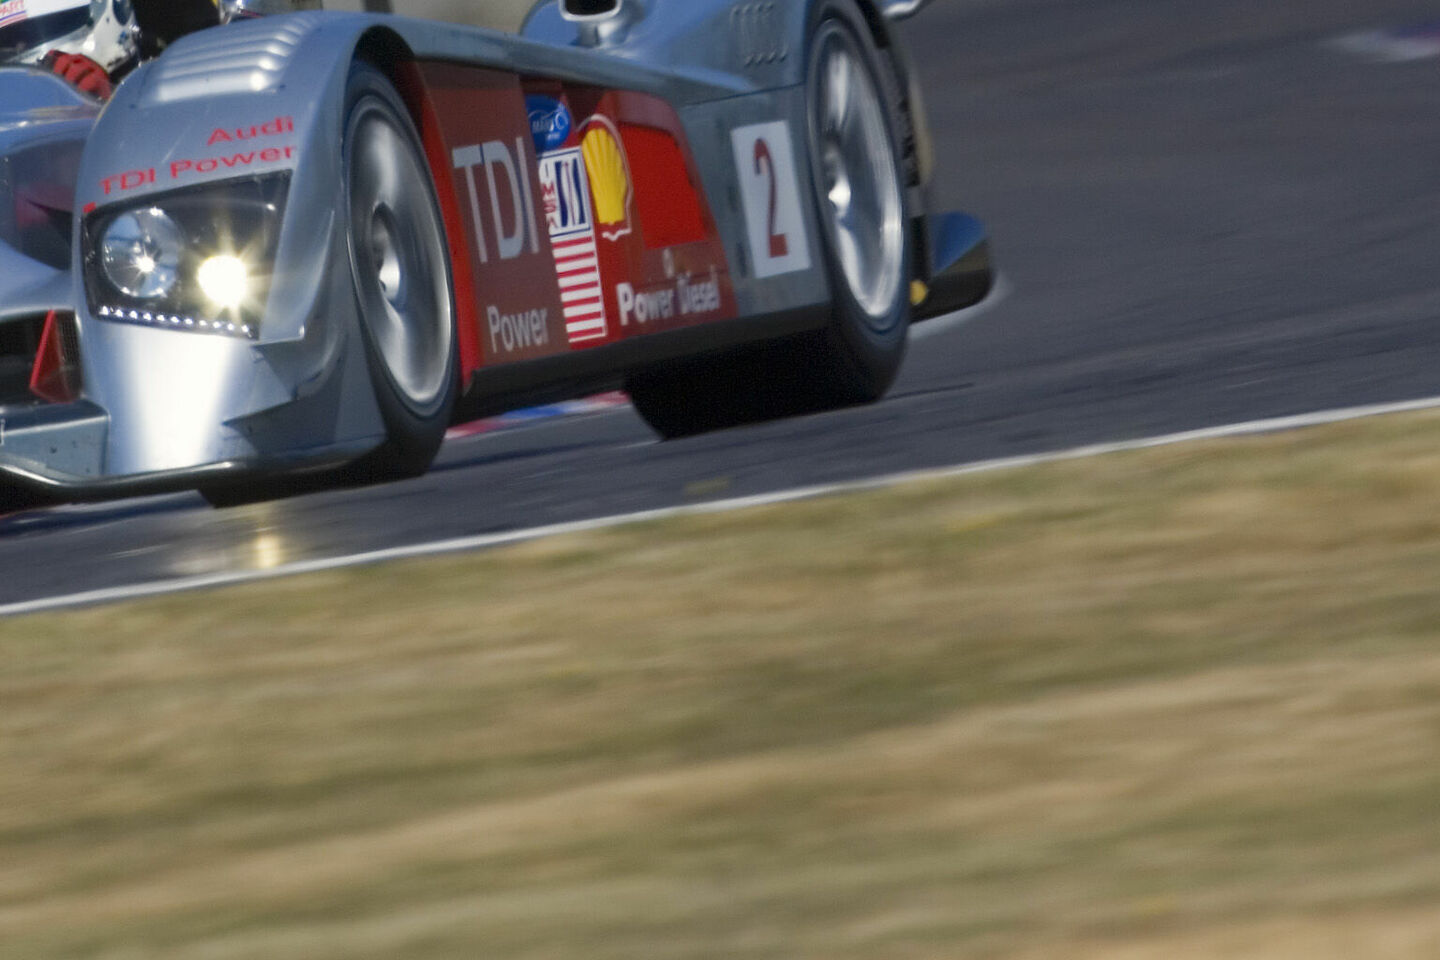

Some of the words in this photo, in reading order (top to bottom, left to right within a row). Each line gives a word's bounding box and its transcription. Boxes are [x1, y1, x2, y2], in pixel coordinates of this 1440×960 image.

[206, 115, 295, 147] Audi
[99, 167, 157, 195] TDI
[169, 145, 297, 179] Power
[752, 137, 789, 259] 2
[451, 136, 539, 264] TDI
[616, 282, 675, 327] Power
[675, 263, 722, 315] Diesel
[486, 305, 550, 354] Power
